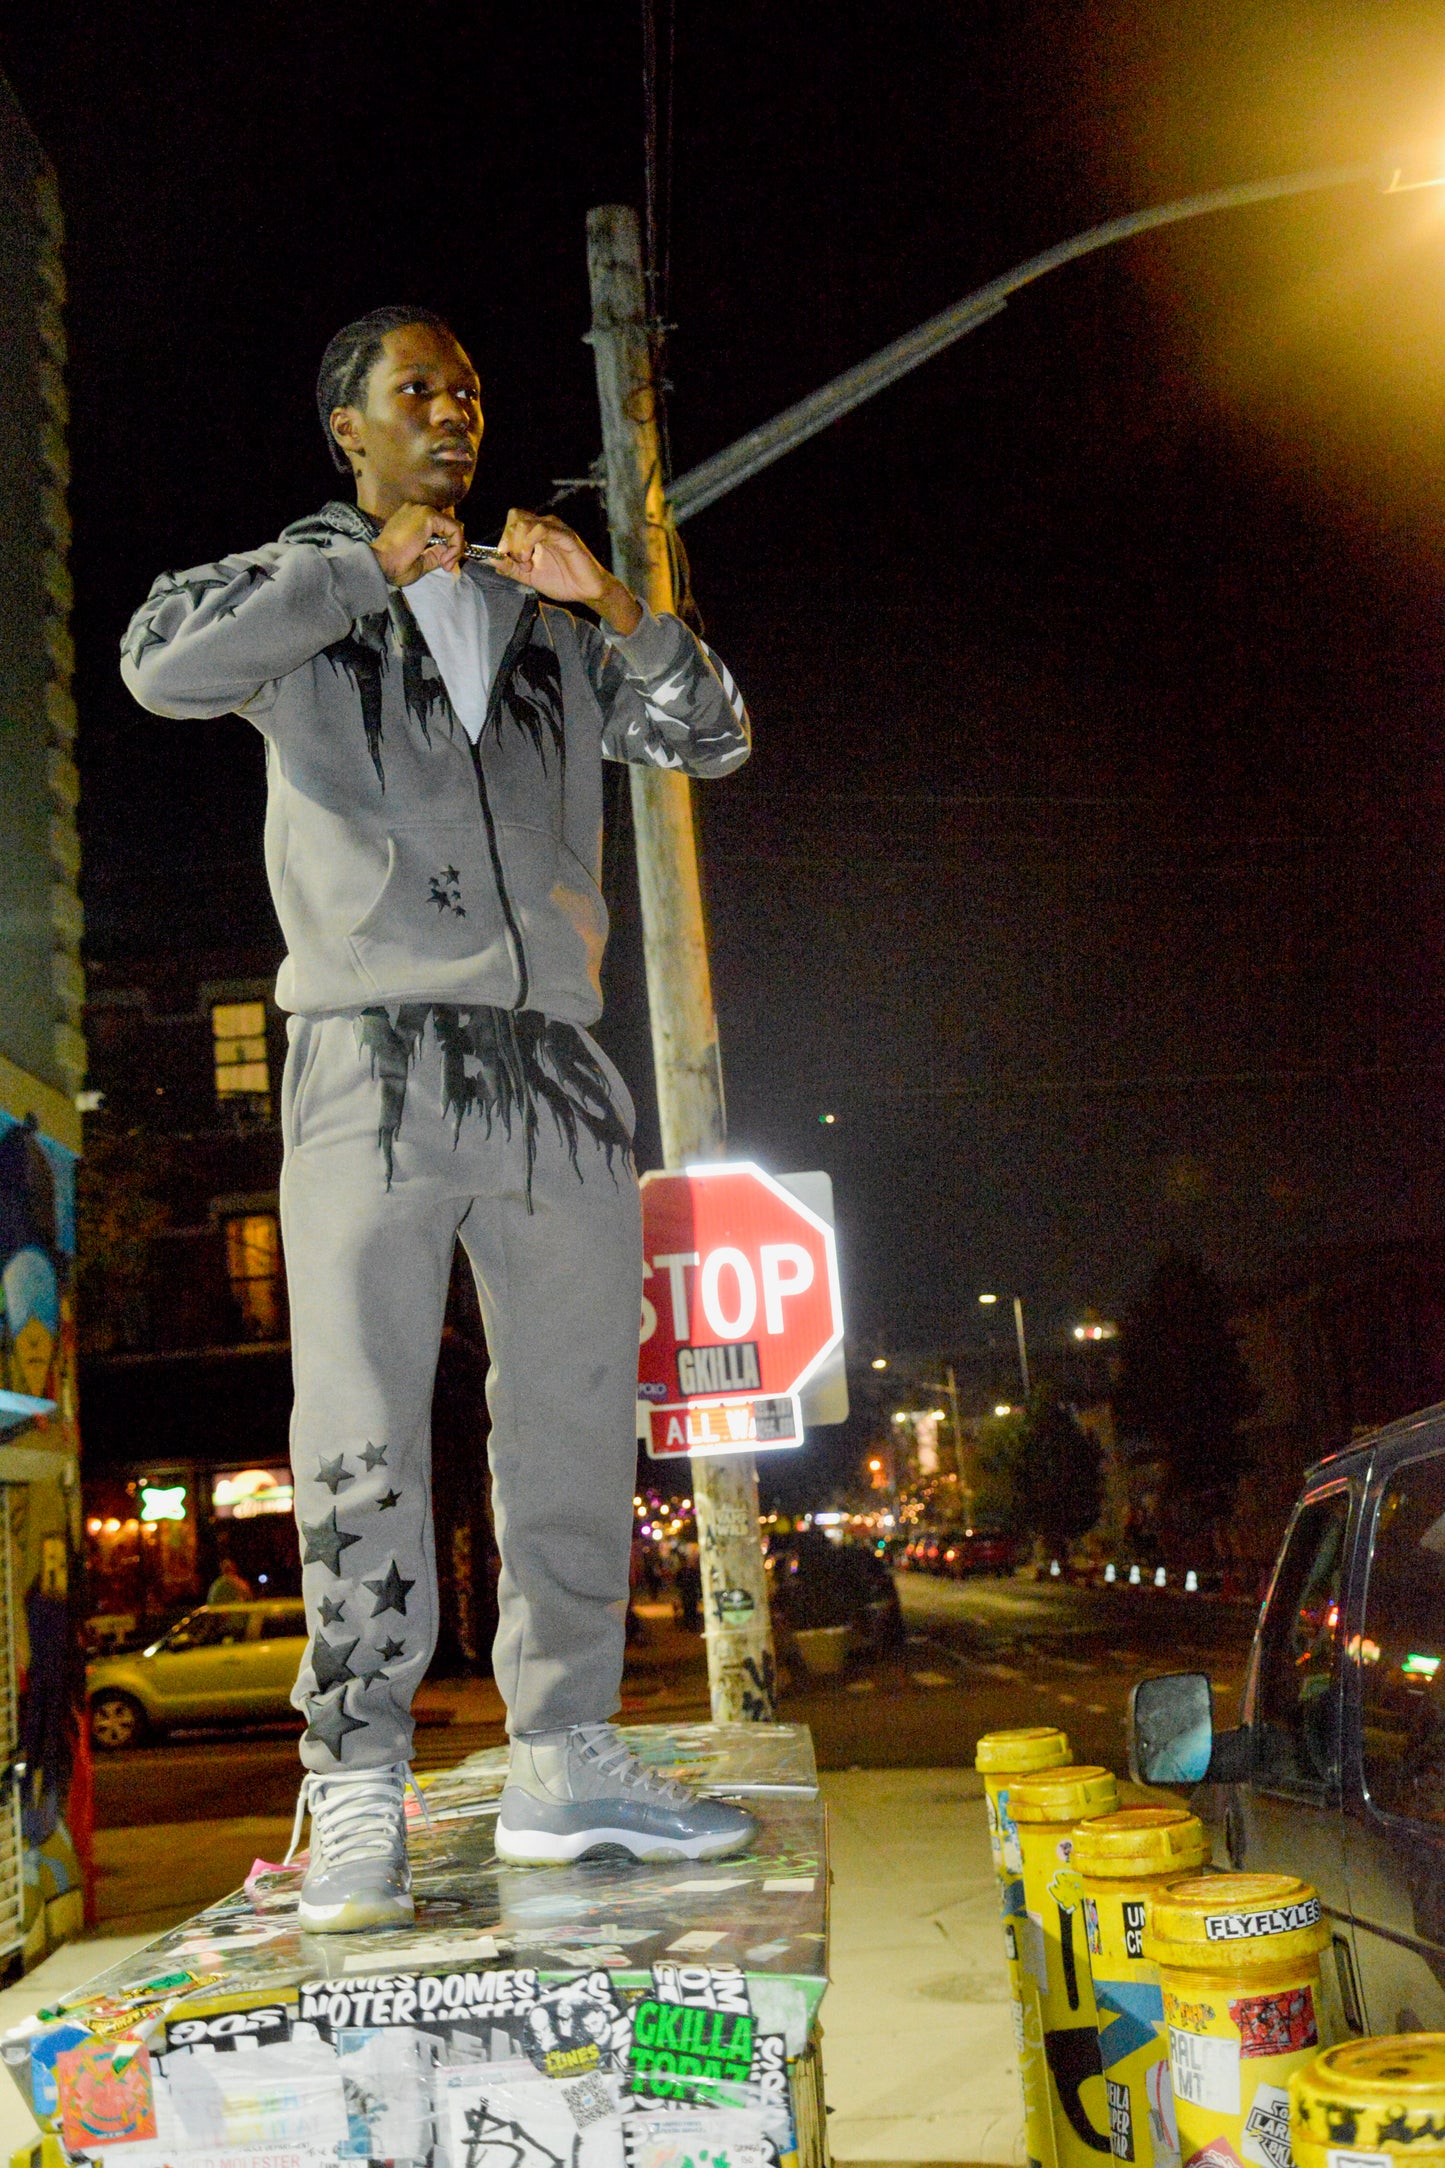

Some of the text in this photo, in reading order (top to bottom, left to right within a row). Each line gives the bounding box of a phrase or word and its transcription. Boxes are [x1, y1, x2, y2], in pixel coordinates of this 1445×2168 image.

[678, 1343, 760, 1396] GKILLA
[666, 1411, 721, 1446] ALL
[301, 1989, 418, 2029] NOTER
[418, 1968, 537, 2011] DOMES
[632, 2000, 754, 2063] GKILLA
[1107, 2081, 1129, 2111] EILA
